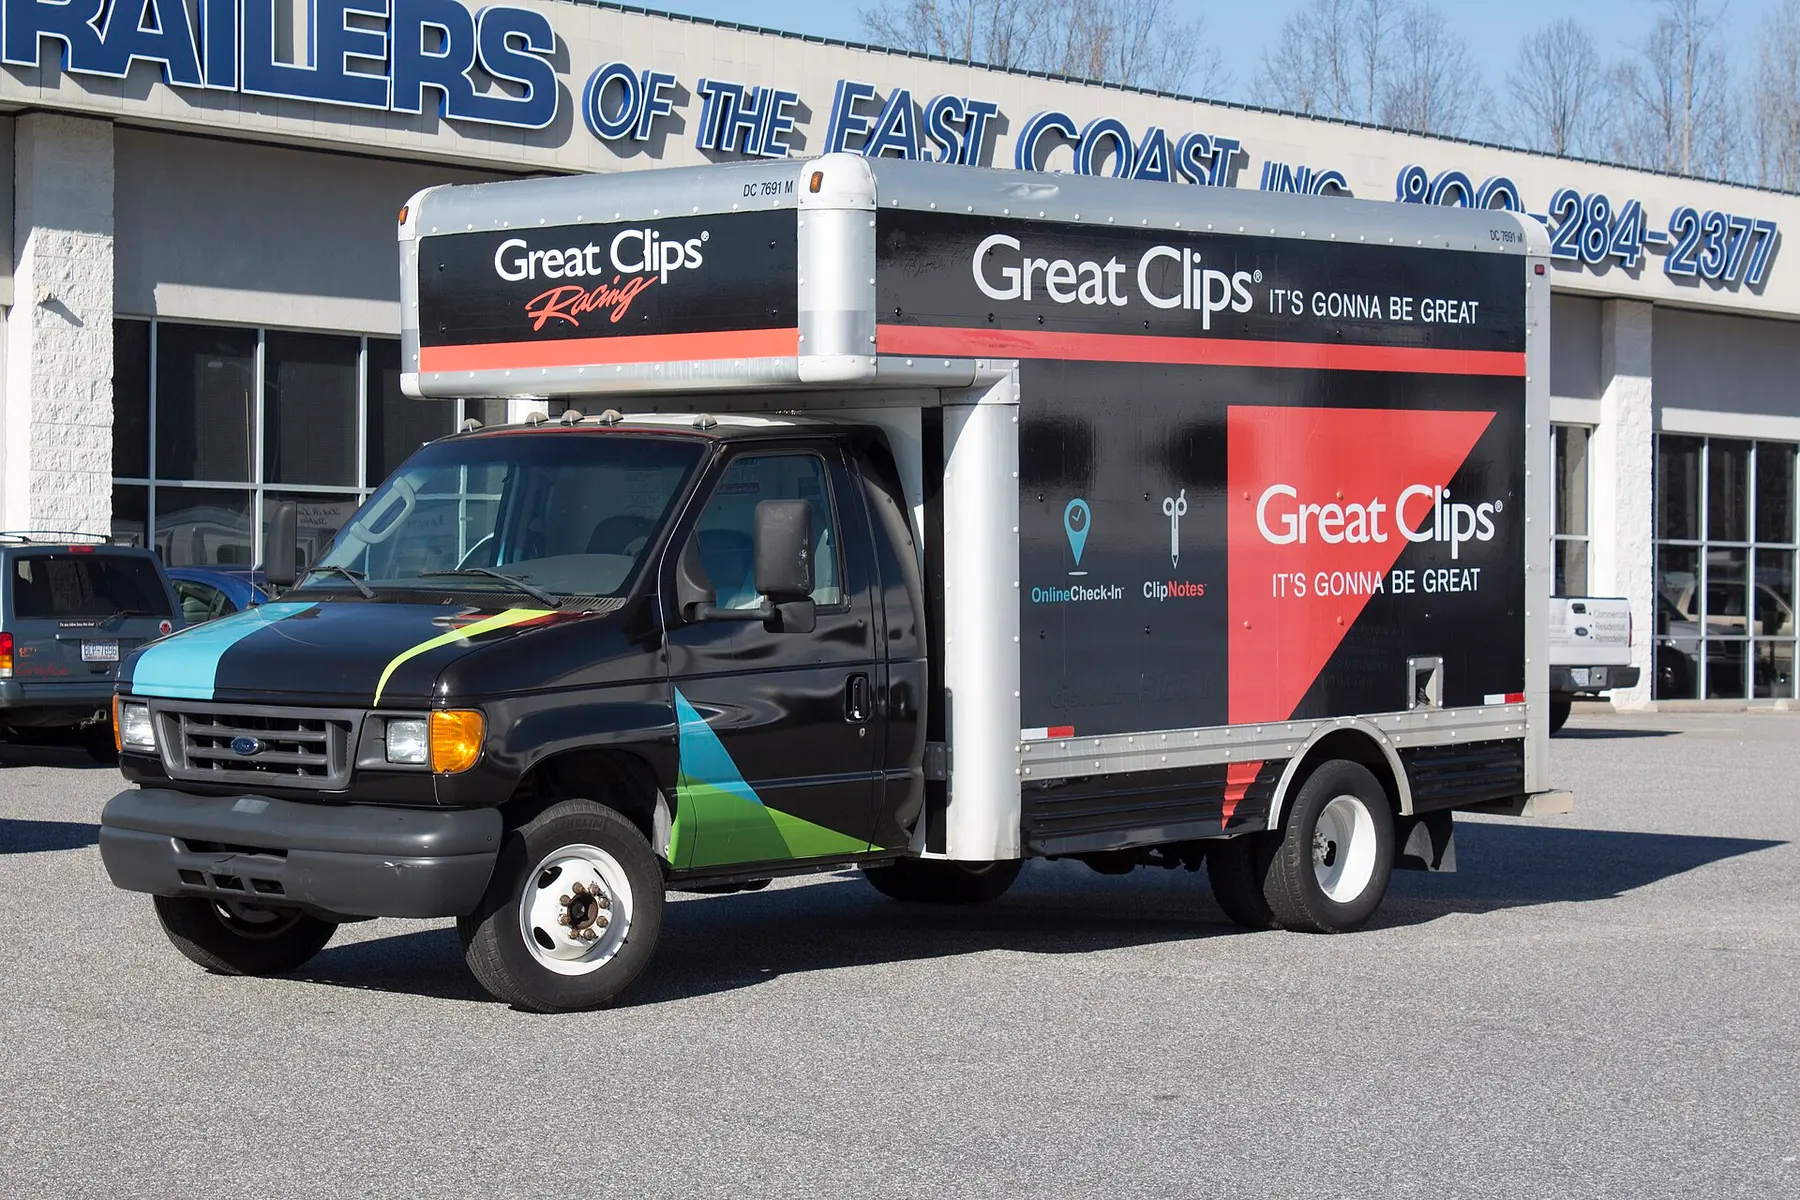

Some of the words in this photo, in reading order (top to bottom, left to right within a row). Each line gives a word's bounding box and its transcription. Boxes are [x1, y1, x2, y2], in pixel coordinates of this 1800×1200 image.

[582, 61, 676, 141] OF
[696, 78, 800, 158] THE
[825, 79, 999, 166] EAST
[1015, 110, 1241, 188] COAST
[743, 183, 757, 197] DC
[761, 181, 781, 196] 7691
[785, 180, 793, 194] M
[494, 238, 602, 282] Great
[1490, 229, 1500, 242] DC
[1500, 230, 1516, 243] 7691
[524, 275, 658, 332] Racing
[972, 233, 1128, 307] Great
[1269, 288, 1304, 316] IT'S
[1311, 291, 1383, 320] GONNA
[1389, 296, 1414, 321] BE
[1420, 298, 1479, 325] GREAT
[1255, 483, 1388, 545] Great
[1272, 572, 1307, 598] IT'S
[1314, 570, 1385, 597] GONNA
[1392, 569, 1416, 594] BE
[1422, 568, 1481, 593] GREAT
